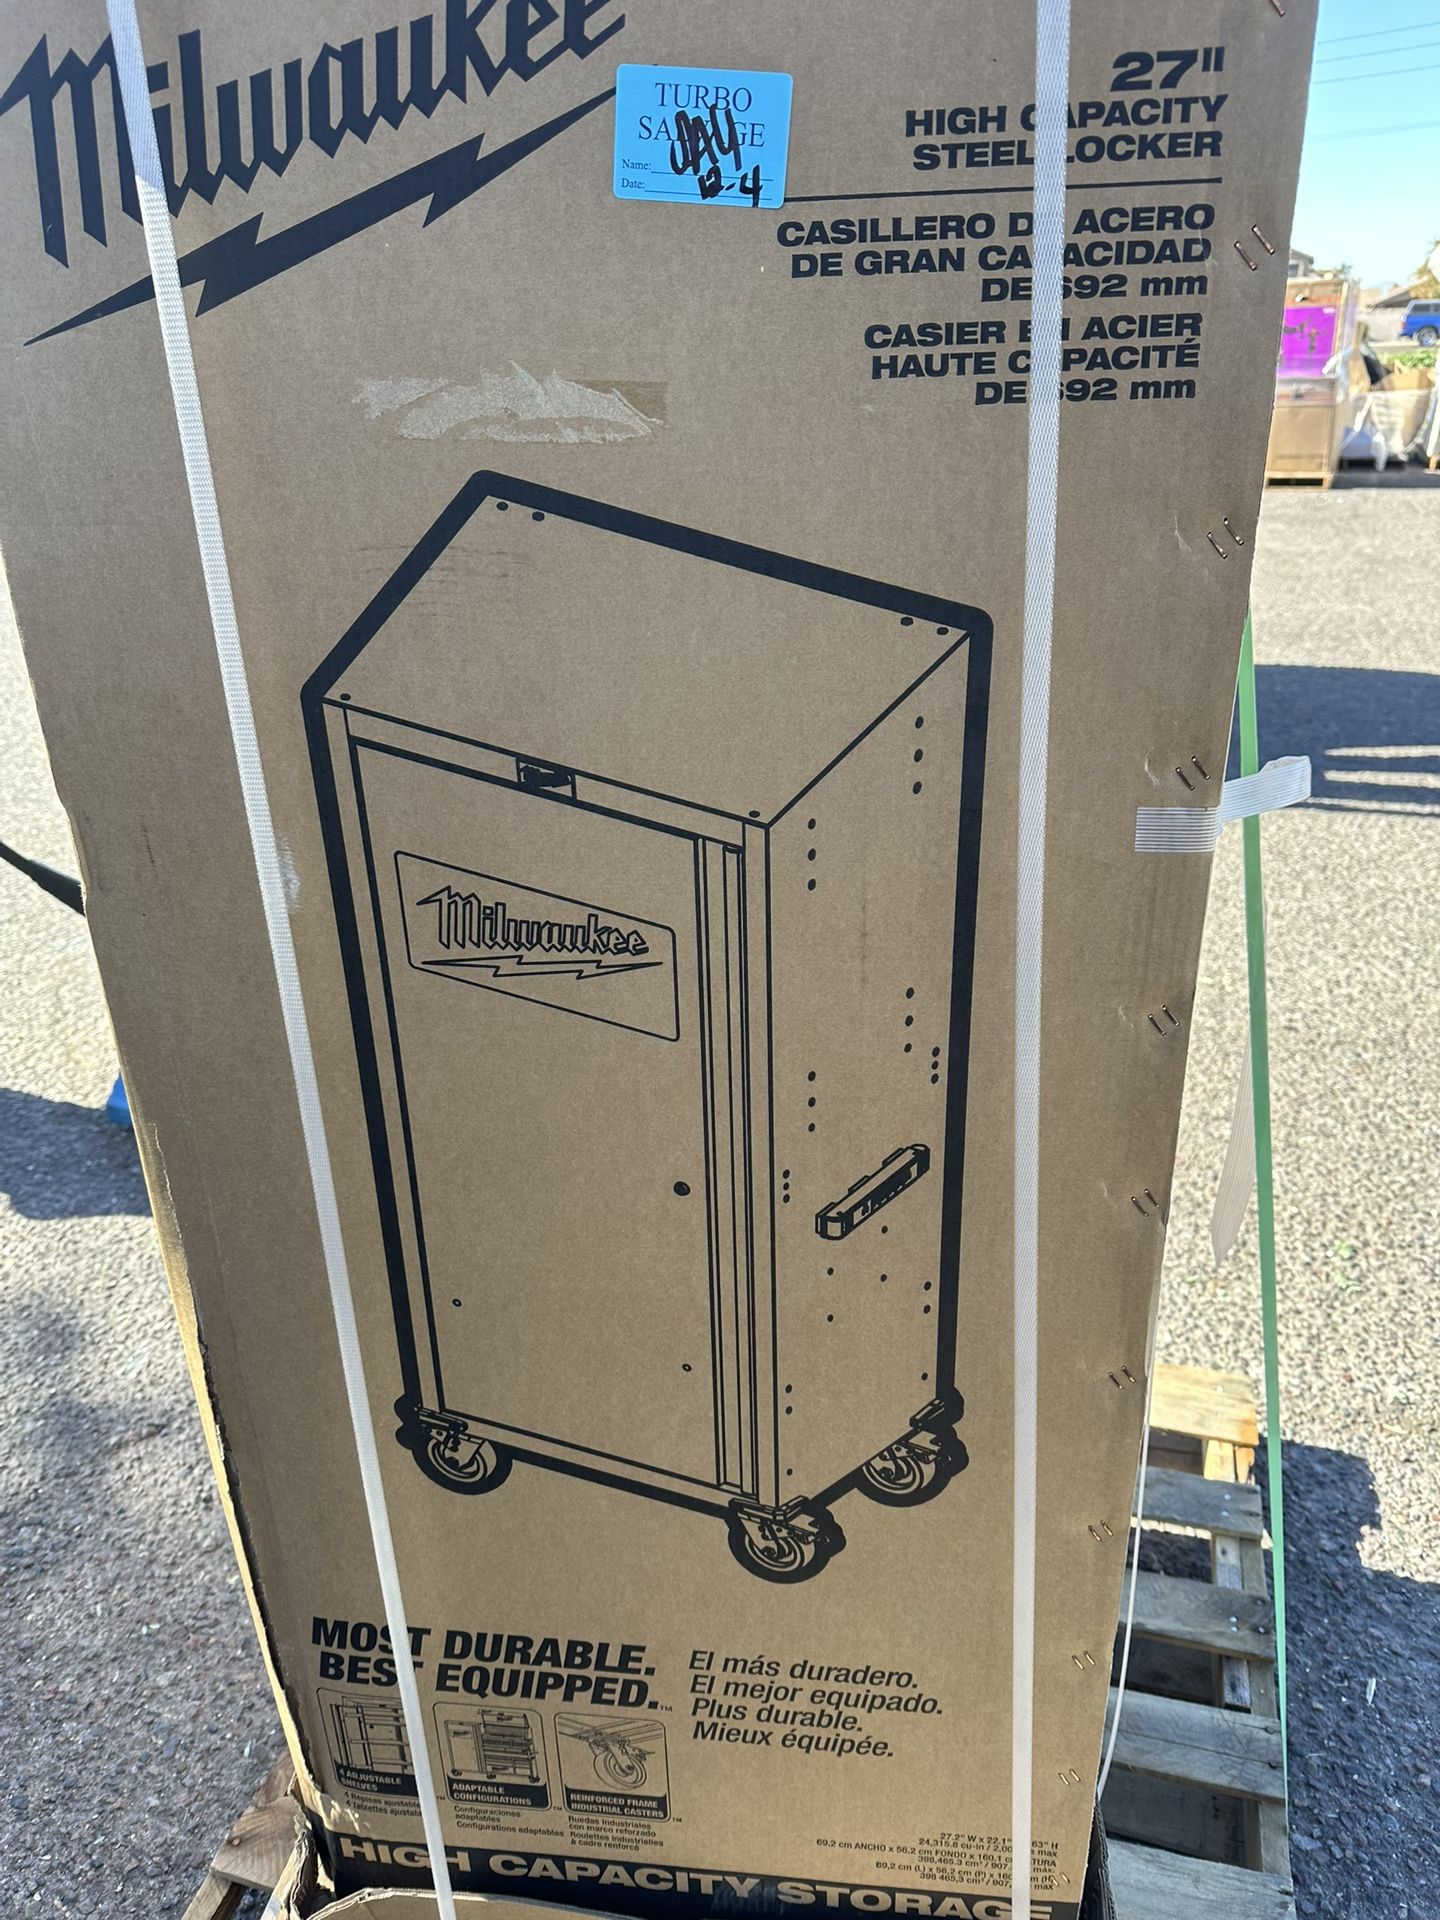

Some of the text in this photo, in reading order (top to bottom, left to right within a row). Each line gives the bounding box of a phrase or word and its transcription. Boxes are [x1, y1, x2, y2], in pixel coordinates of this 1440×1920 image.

[655, 83, 752, 113] TURBO
[905, 94, 1229, 138] HIGH CPACITY
[0, 0, 625, 268] Milwaukee
[638, 115, 766, 148] SAGE
[621, 159, 652, 171] Name:
[913, 131, 1223, 171] STEEL OCKER
[621, 178, 646, 190] Date:
[776, 213, 996, 248] CASILLERO
[1072, 203, 1216, 236] ACERO
[791, 238, 1212, 279] DE GRAN CAACIDAD
[981, 277, 1032, 303] DE
[1141, 273, 1208, 297] mm
[864, 319, 1007, 350] CASIER
[1081, 312, 1203, 342] ACIER
[872, 338, 1201, 380] HAUTE CPACITÉ
[975, 377, 1197, 405] DE 92 mm
[416, 884, 650, 957] Milwaukee
[312, 1617, 657, 1676] MOST DURABLE.
[688, 1650, 919, 1689] El más duradero.
[435, 1662, 660, 1710] EQUIPPED.
[690, 1674, 943, 1716] El mejor equipado.
[691, 1697, 863, 1732] Plus durable.
[692, 1720, 894, 1758] Mieux équipée.
[341, 1777, 378, 1791] SHELVES
[346, 1769, 402, 1785] ADJUSTABLE
[452, 1783, 505, 1794] ADAPTABLE
[384, 1799, 421, 1810] ajustable
[453, 1792, 532, 1806] CONFIGURATIONS
[454, 1805, 521, 1817] Configuraciones
[570, 1793, 658, 1809] REINFORCED FRAME
[571, 1802, 664, 1818] INDUSTRIAL CASTERS
[455, 1813, 501, 1823] adaptables
[456, 1821, 565, 1838] Configurations adaptables
[568, 1815, 652, 1830] Ruedas industriales
[587, 1825, 614, 1833] marco
[615, 1826, 656, 1838] reforzado
[570, 1831, 664, 1847] Roulettes industrielles
[578, 1839, 602, 1848] cadre
[968, 1834, 977, 1842] W
[1051, 1842, 1059, 1850] H
[1038, 1849, 1057, 1857] max
[816, 1839, 836, 1848] 69.2
[838, 1841, 852, 1849] cm
[854, 1841, 886, 1852] ANCHO
[918, 1848, 933, 1856] cm
[935, 1849, 967, 1859] FONDO
[1031, 1858, 1057, 1868] TURA
[340, 1837, 471, 1873] HIGH
[488, 1854, 760, 1899] CAPACITY
[898, 1863, 912, 1871] cm
[914, 1864, 925, 1873] (L)
